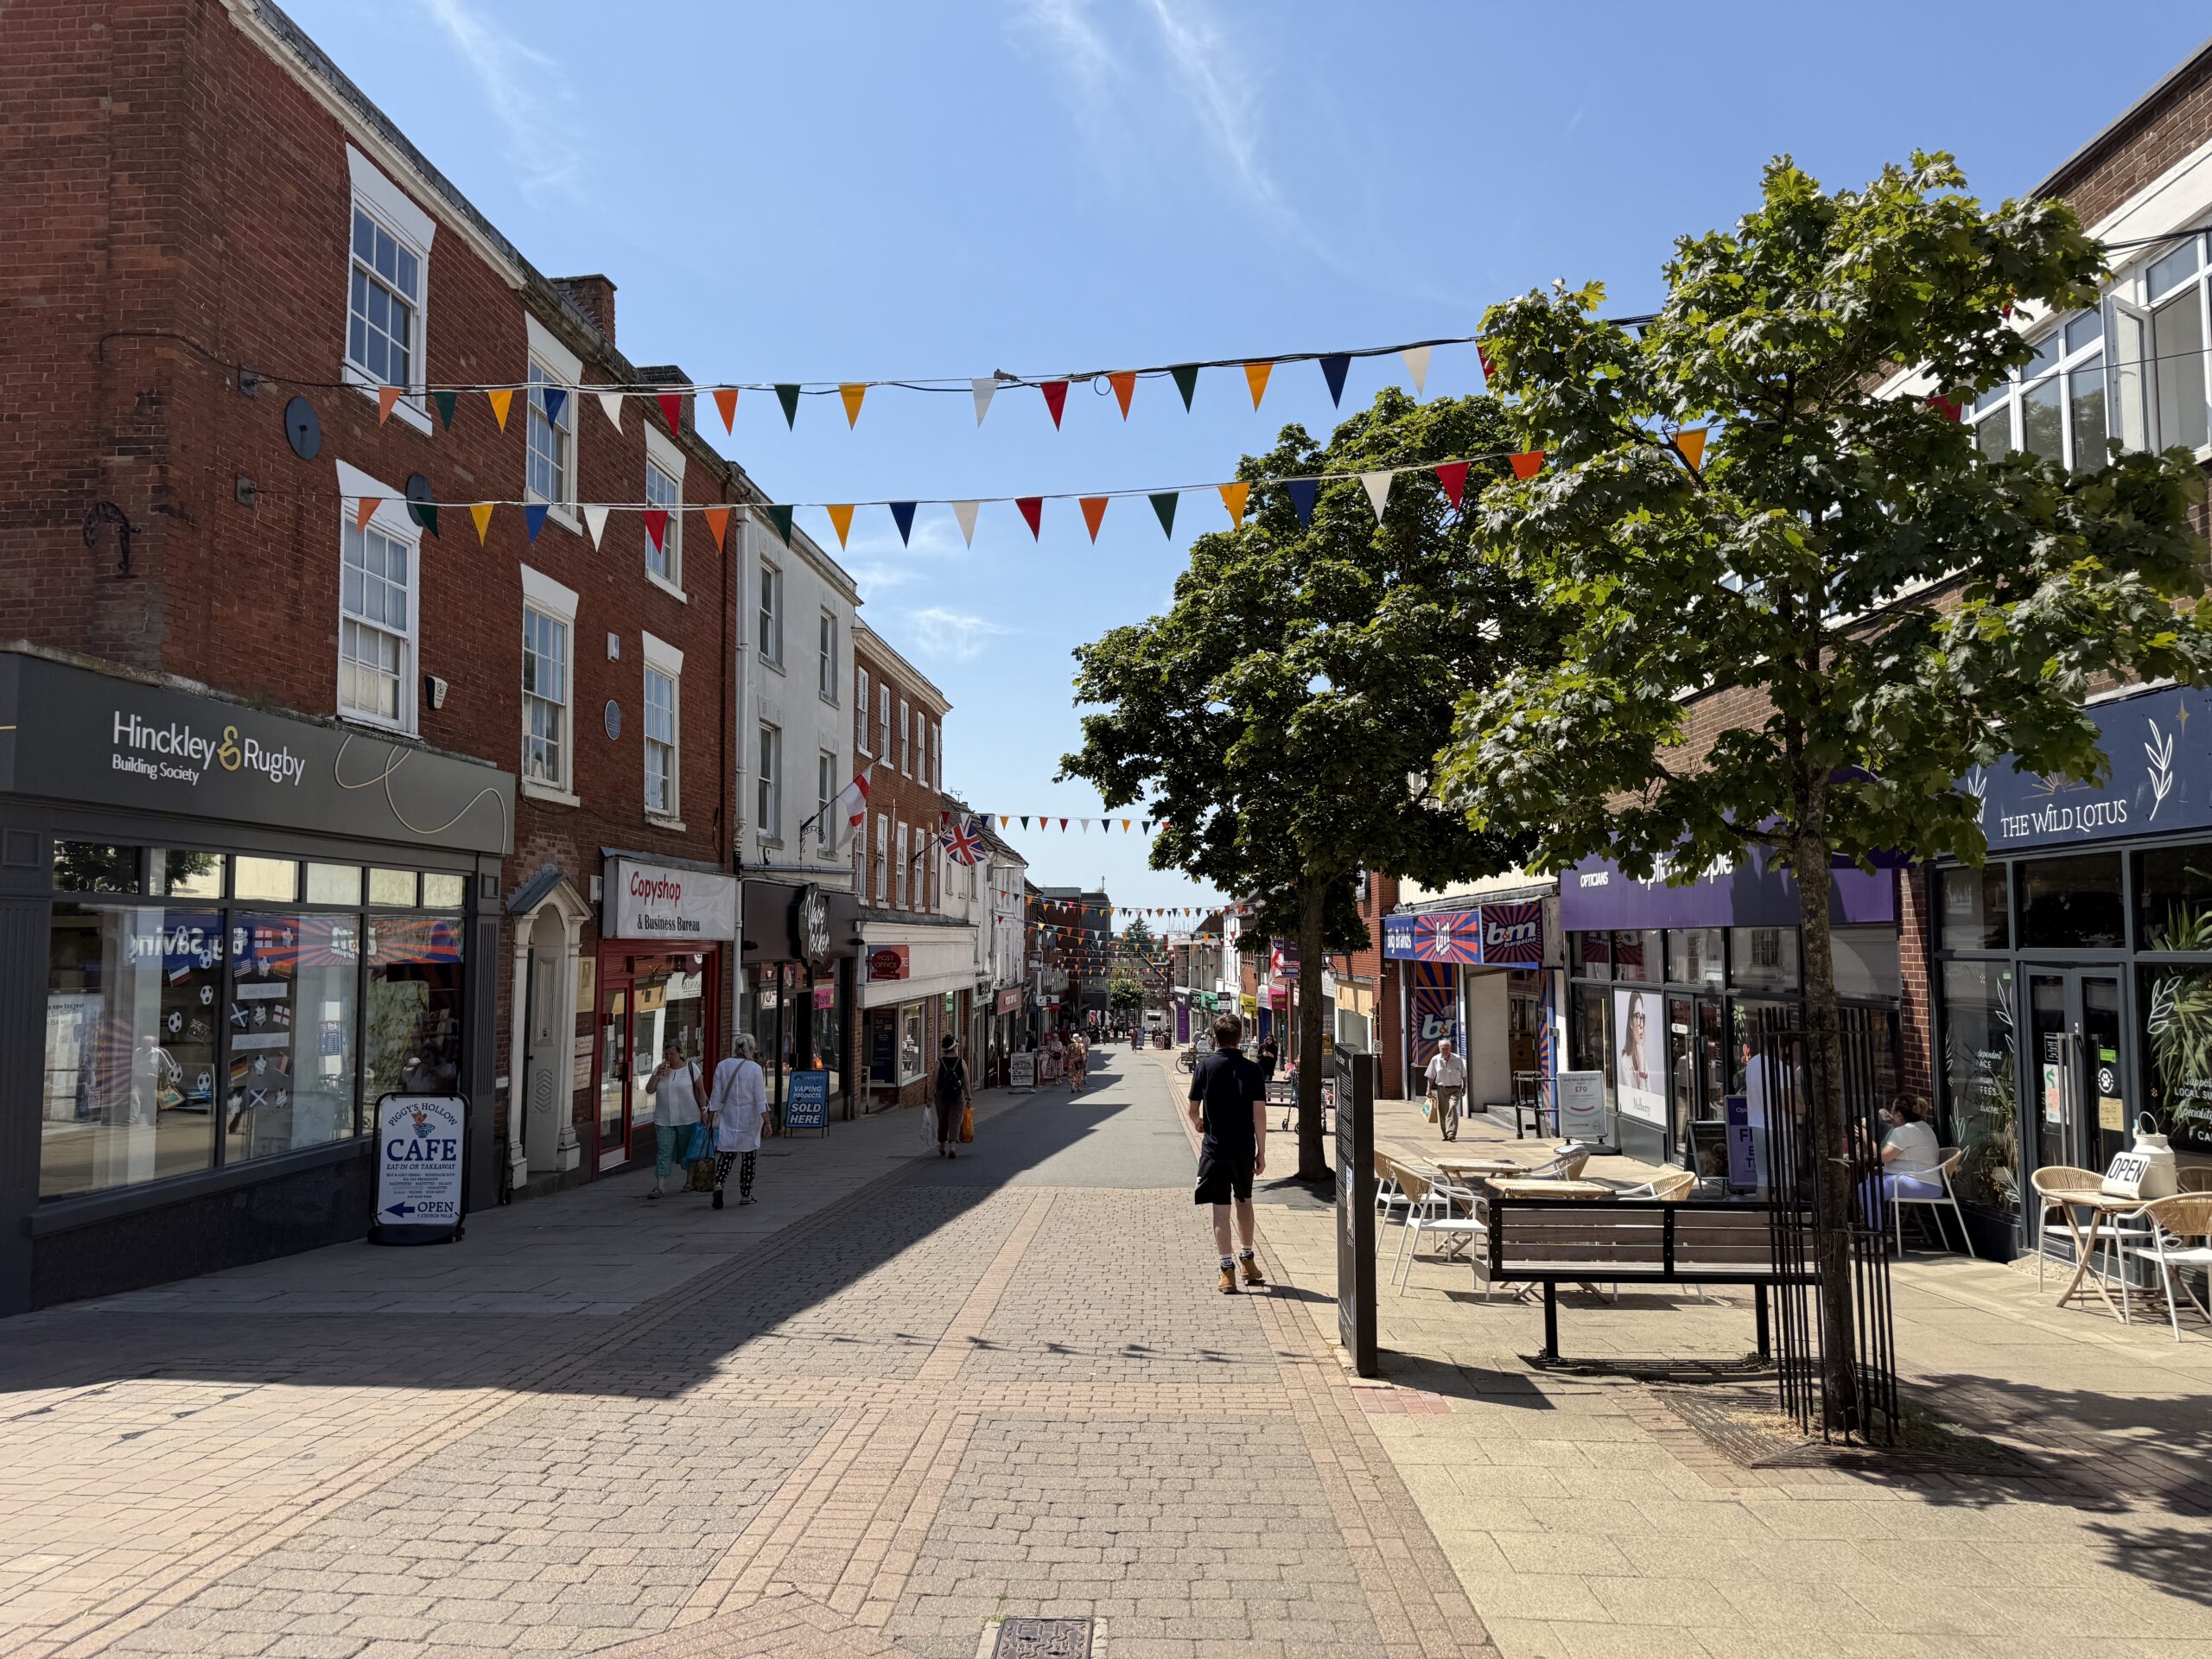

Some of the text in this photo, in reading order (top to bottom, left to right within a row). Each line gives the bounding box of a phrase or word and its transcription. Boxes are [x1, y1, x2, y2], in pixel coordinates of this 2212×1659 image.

[113, 710, 305, 785] Hinckley & Rugby
[112, 753, 200, 785] Building Society
[2000, 799, 2127, 837] THE WILD LOTUS
[630, 870, 681, 907] Copyshop
[1580, 871, 1608, 888] OPTICIANS
[637, 914, 700, 931] & Business Bureau
[1486, 921, 1537, 945] b&m
[1503, 936, 1537, 948] bargains
[2174, 1086, 2200, 1098] LOCAL
[388, 1103, 458, 1127] PIGGY'S HOLLOW
[791, 1103, 822, 1112] SOLD
[1633, 1096, 1650, 1116] Mulberry
[789, 1115, 821, 1124] HERE
[386, 1139, 457, 1161] CAFE
[2108, 1158, 2148, 1183] OPEN
[417, 1201, 454, 1212] OPEN
